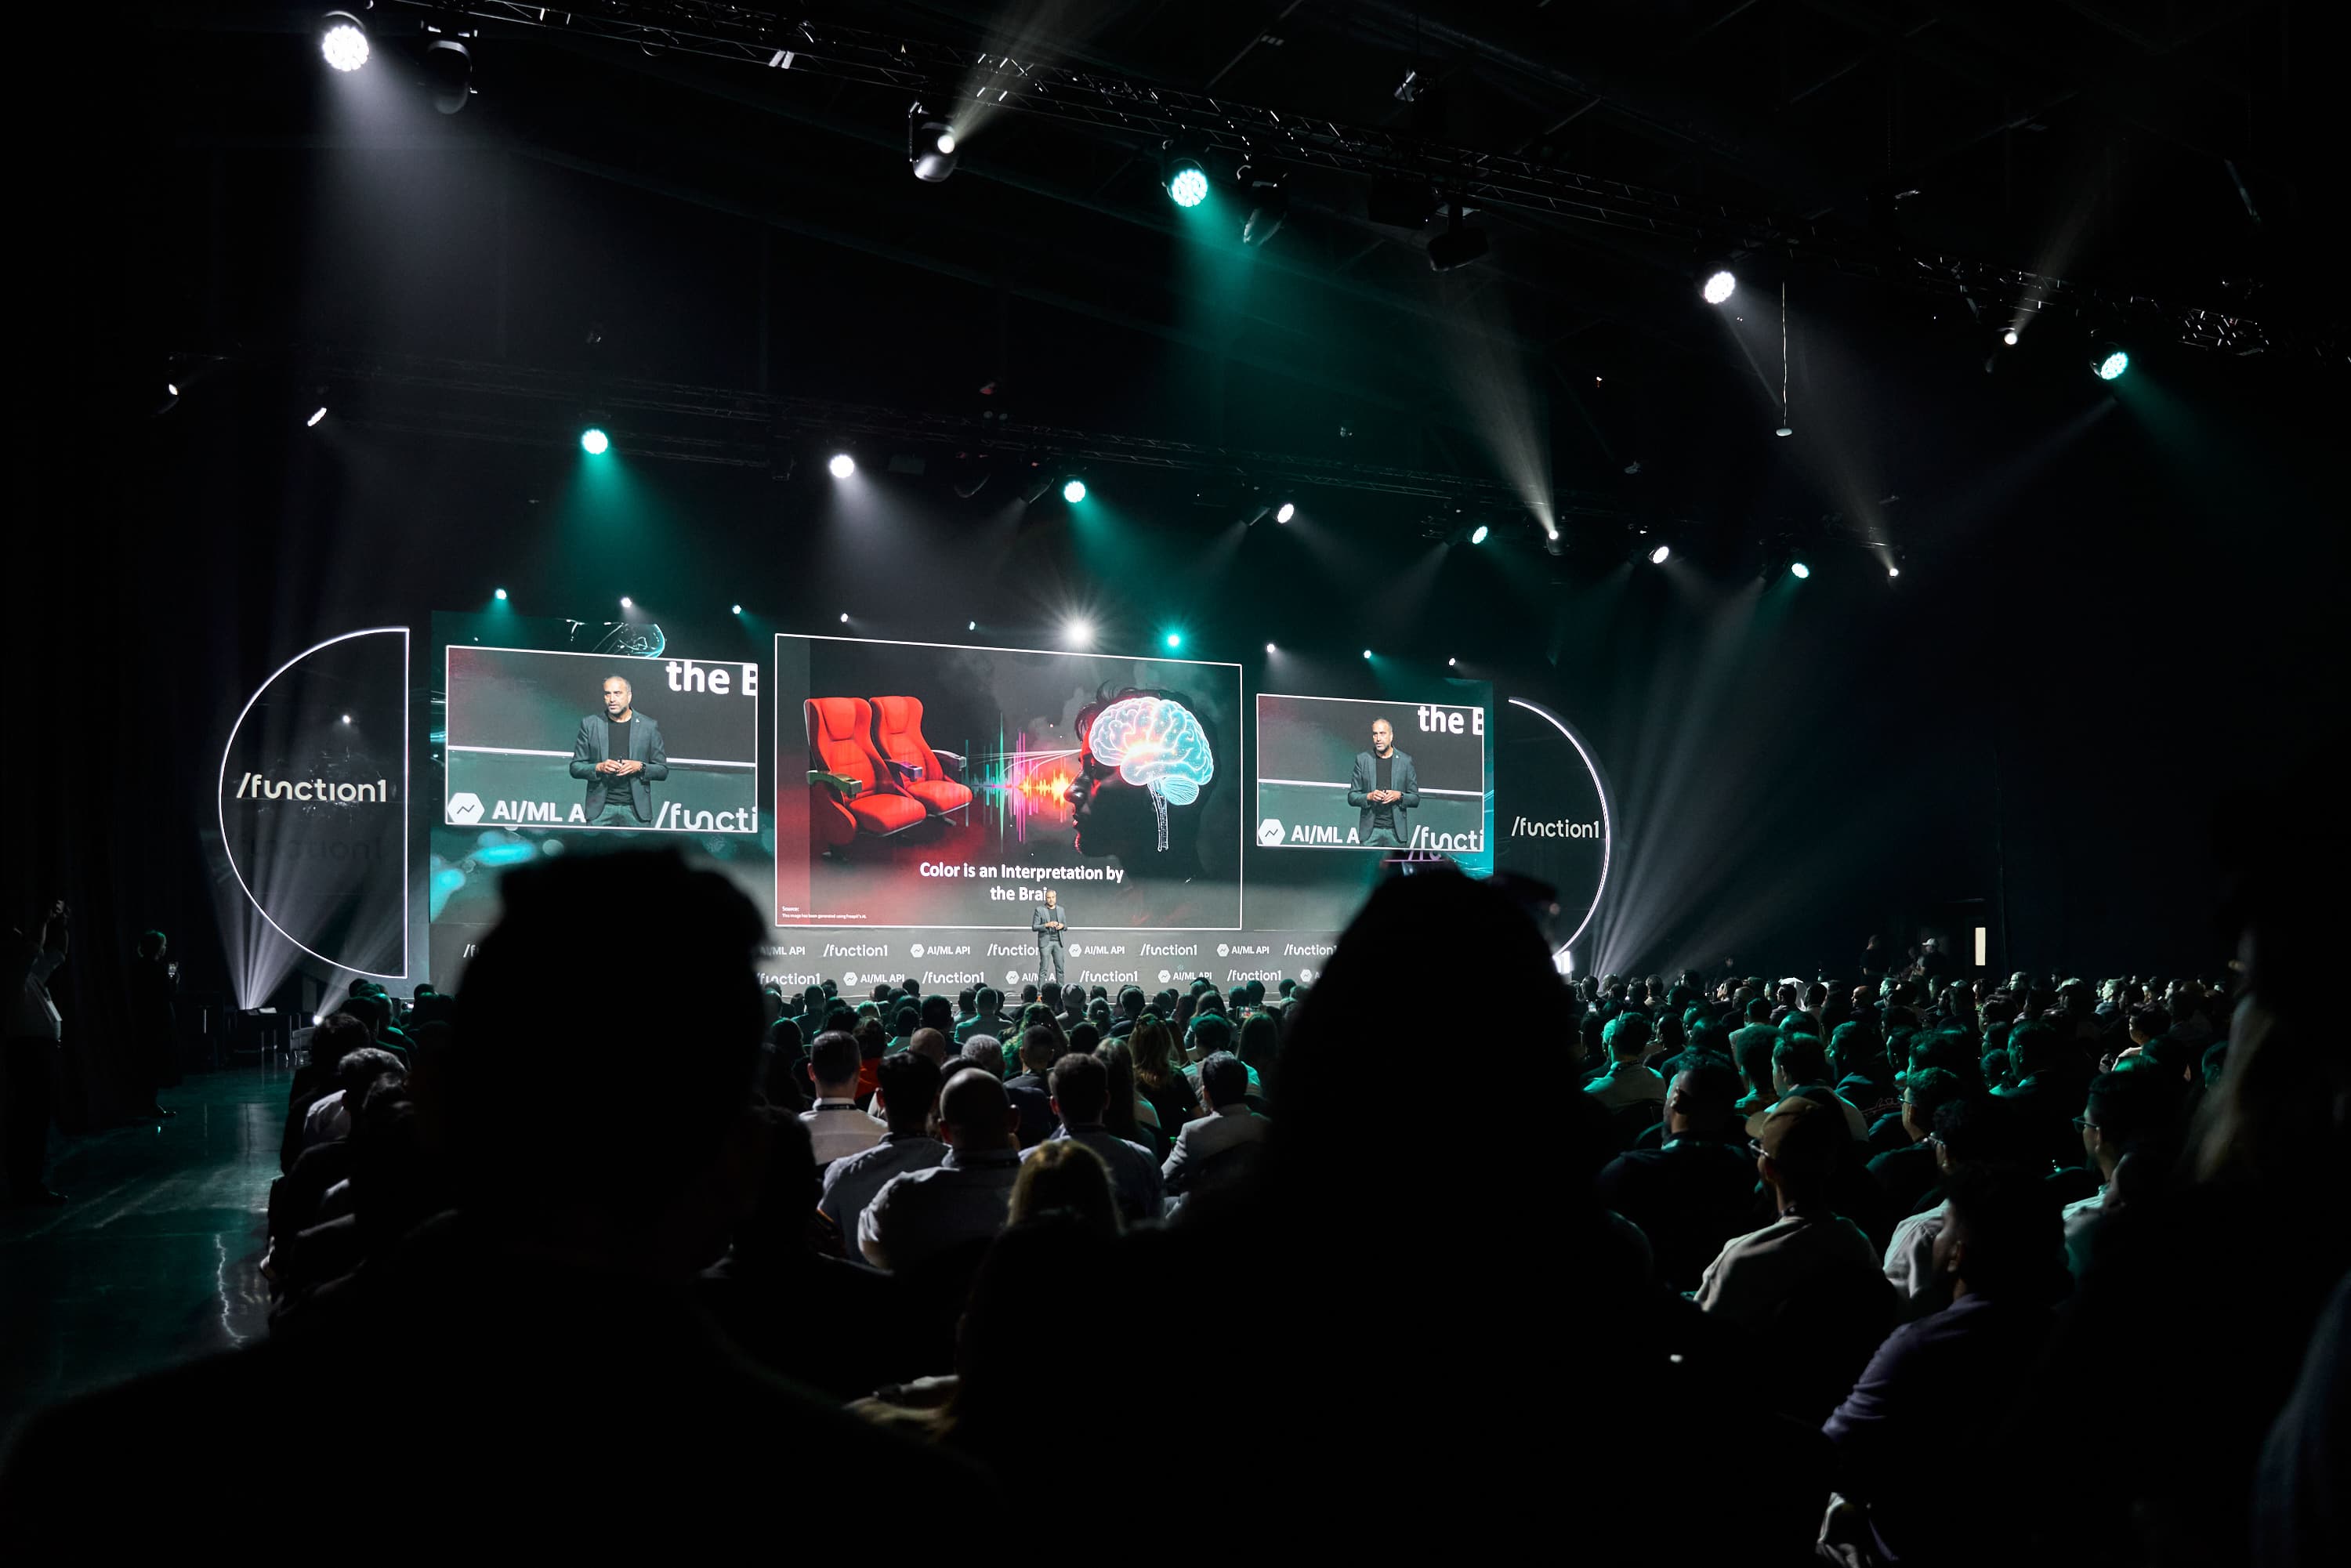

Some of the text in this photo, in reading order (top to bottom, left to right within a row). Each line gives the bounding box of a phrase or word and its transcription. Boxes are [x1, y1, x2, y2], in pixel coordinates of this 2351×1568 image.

[665, 660, 730, 694] the
[1417, 705, 1464, 733] the
[236, 773, 386, 802] /function1
[491, 801, 563, 823] AI/ML
[1511, 816, 1599, 838] /function1
[1291, 825, 1343, 844] AI/ML
[920, 862, 1124, 883] Color is an Interpretation by
[991, 886, 1047, 901] the Brai
[789, 946, 806, 955] API
[823, 944, 888, 957] /function1
[927, 946, 971, 955] AI/ML API
[1084, 946, 1125, 954] AI/ML API
[1140, 943, 1197, 956] /function1
[1231, 946, 1270, 954] AI/ML API
[860, 974, 905, 983] AI/ML API
[922, 971, 984, 984] /function1
[1079, 970, 1138, 983] /function1
[1172, 972, 1197, 980] AI/ML
[1226, 969, 1281, 981] /function1
